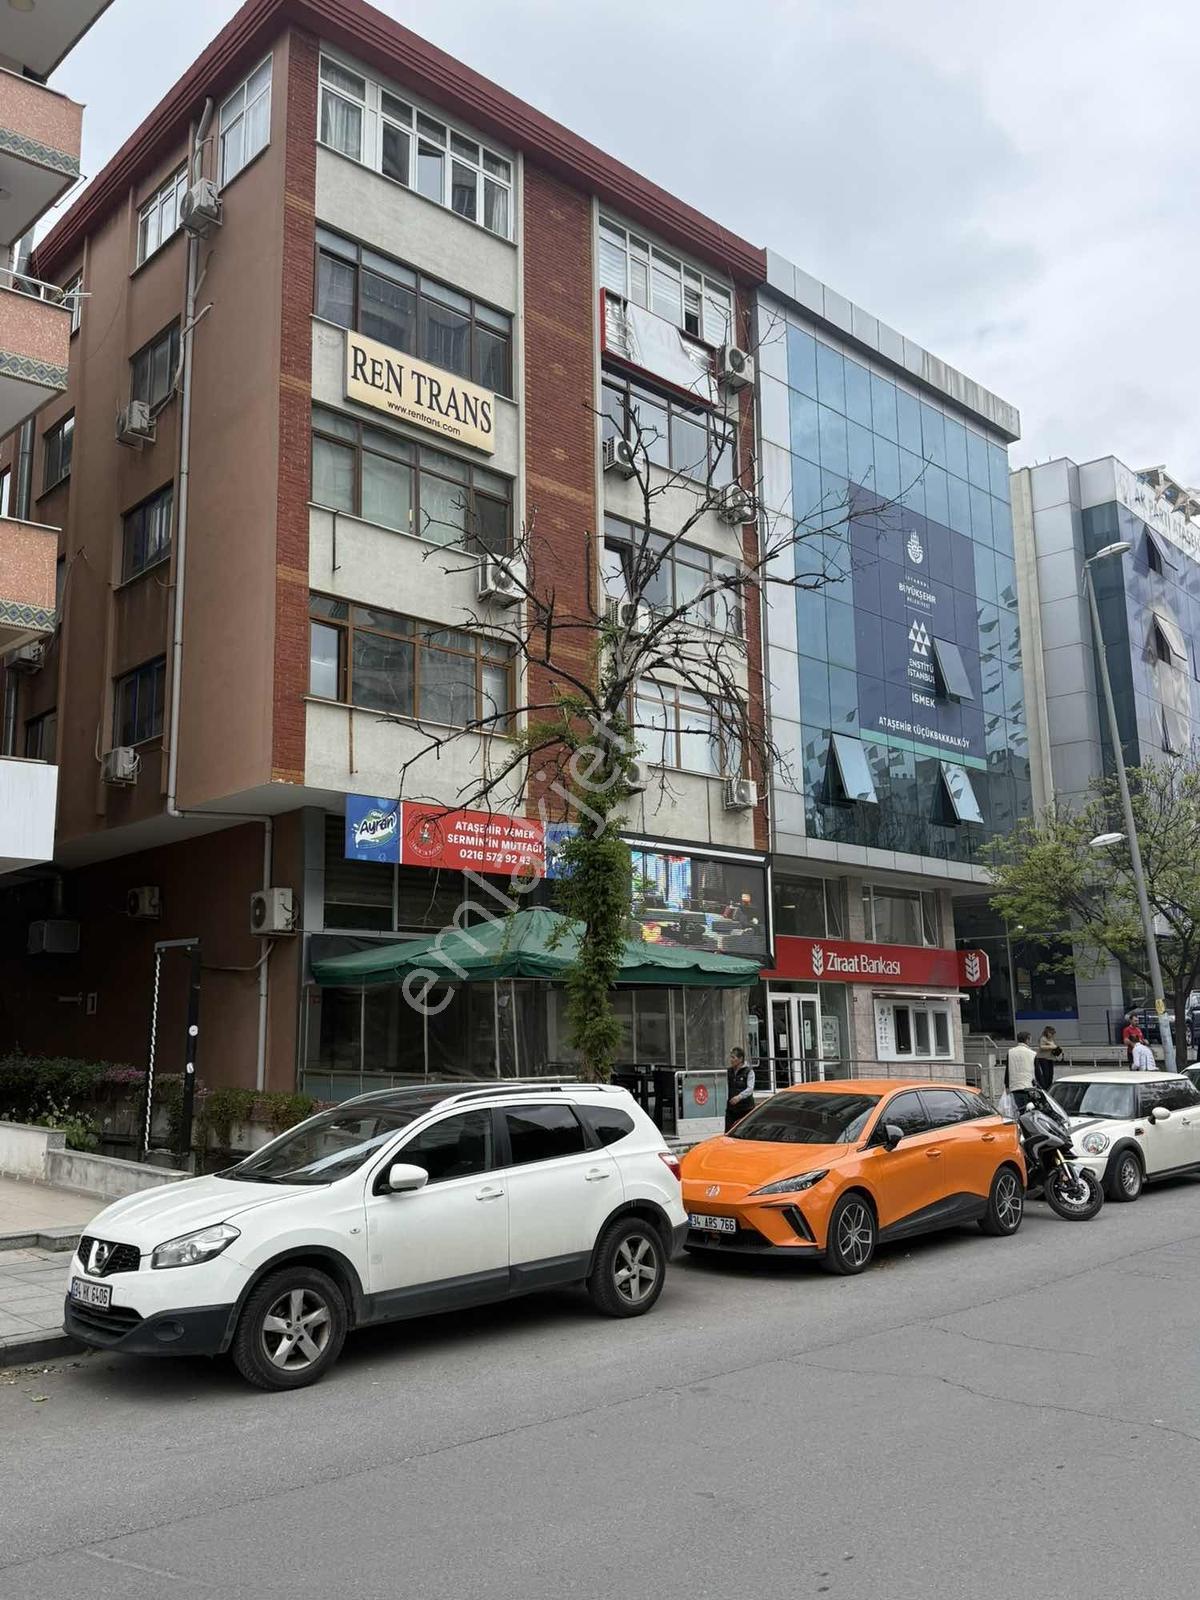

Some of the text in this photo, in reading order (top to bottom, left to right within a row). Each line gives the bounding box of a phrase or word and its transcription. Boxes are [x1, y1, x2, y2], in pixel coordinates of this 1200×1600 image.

[351, 345, 492, 434] REN TRANS
[387, 401, 461, 436] www.rentrans.com
[879, 716, 912, 733] ATAŞEHİR
[360, 816, 394, 835] Ayran
[504, 827, 535, 840] YEMEK
[501, 839, 542, 853] MUTFAĞI
[460, 848, 484, 860] 0216
[486, 852, 503, 862] 572
[505, 854, 517, 864] 92
[826, 952, 900, 975] Ziraat Bankası
[691, 1215, 735, 1231] 34 ARS 766
[74, 1281, 81, 1298] 34
